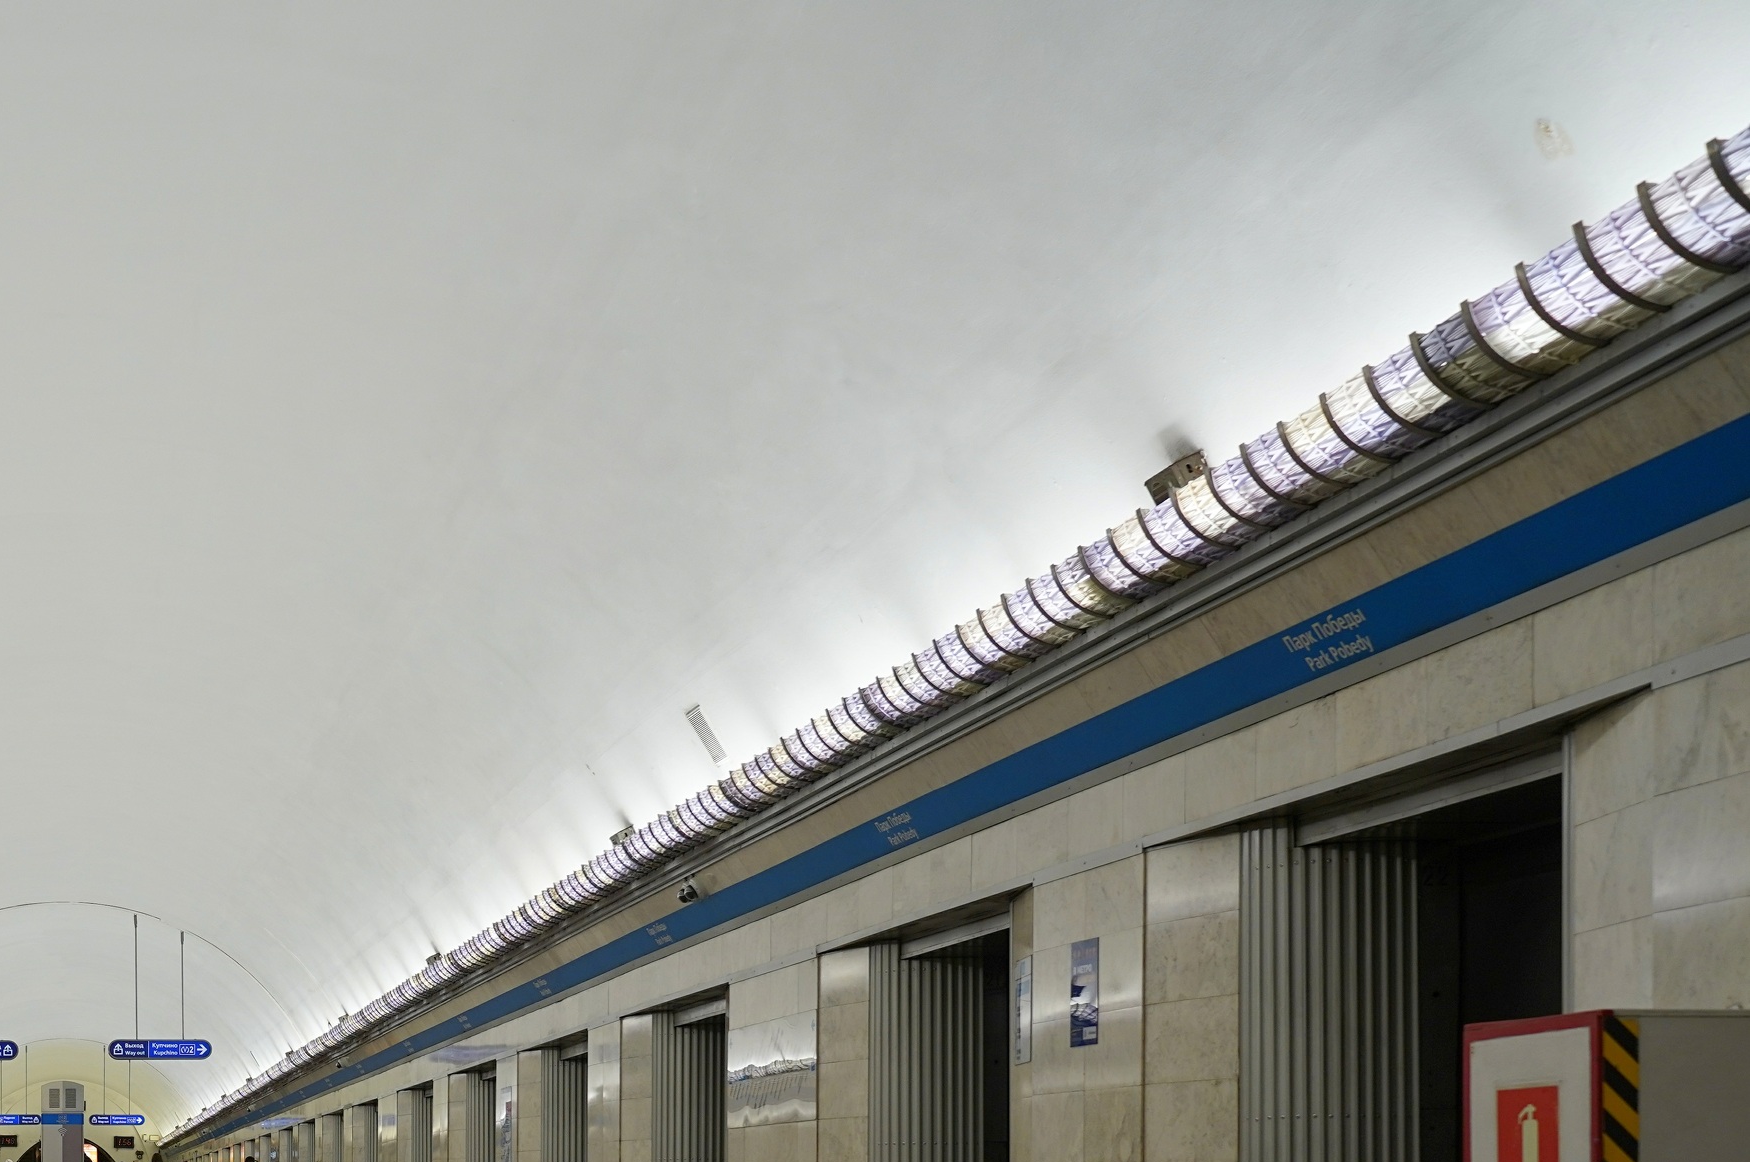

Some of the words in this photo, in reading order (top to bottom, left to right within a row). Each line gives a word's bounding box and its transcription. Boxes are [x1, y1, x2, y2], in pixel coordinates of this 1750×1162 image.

[1282, 631, 1318, 653] Парк
[1311, 608, 1366, 640] Победы
[1305, 650, 1334, 672] Park
[1328, 634, 1375, 662] Pobedy
[152, 1042, 178, 1050] Купчино
